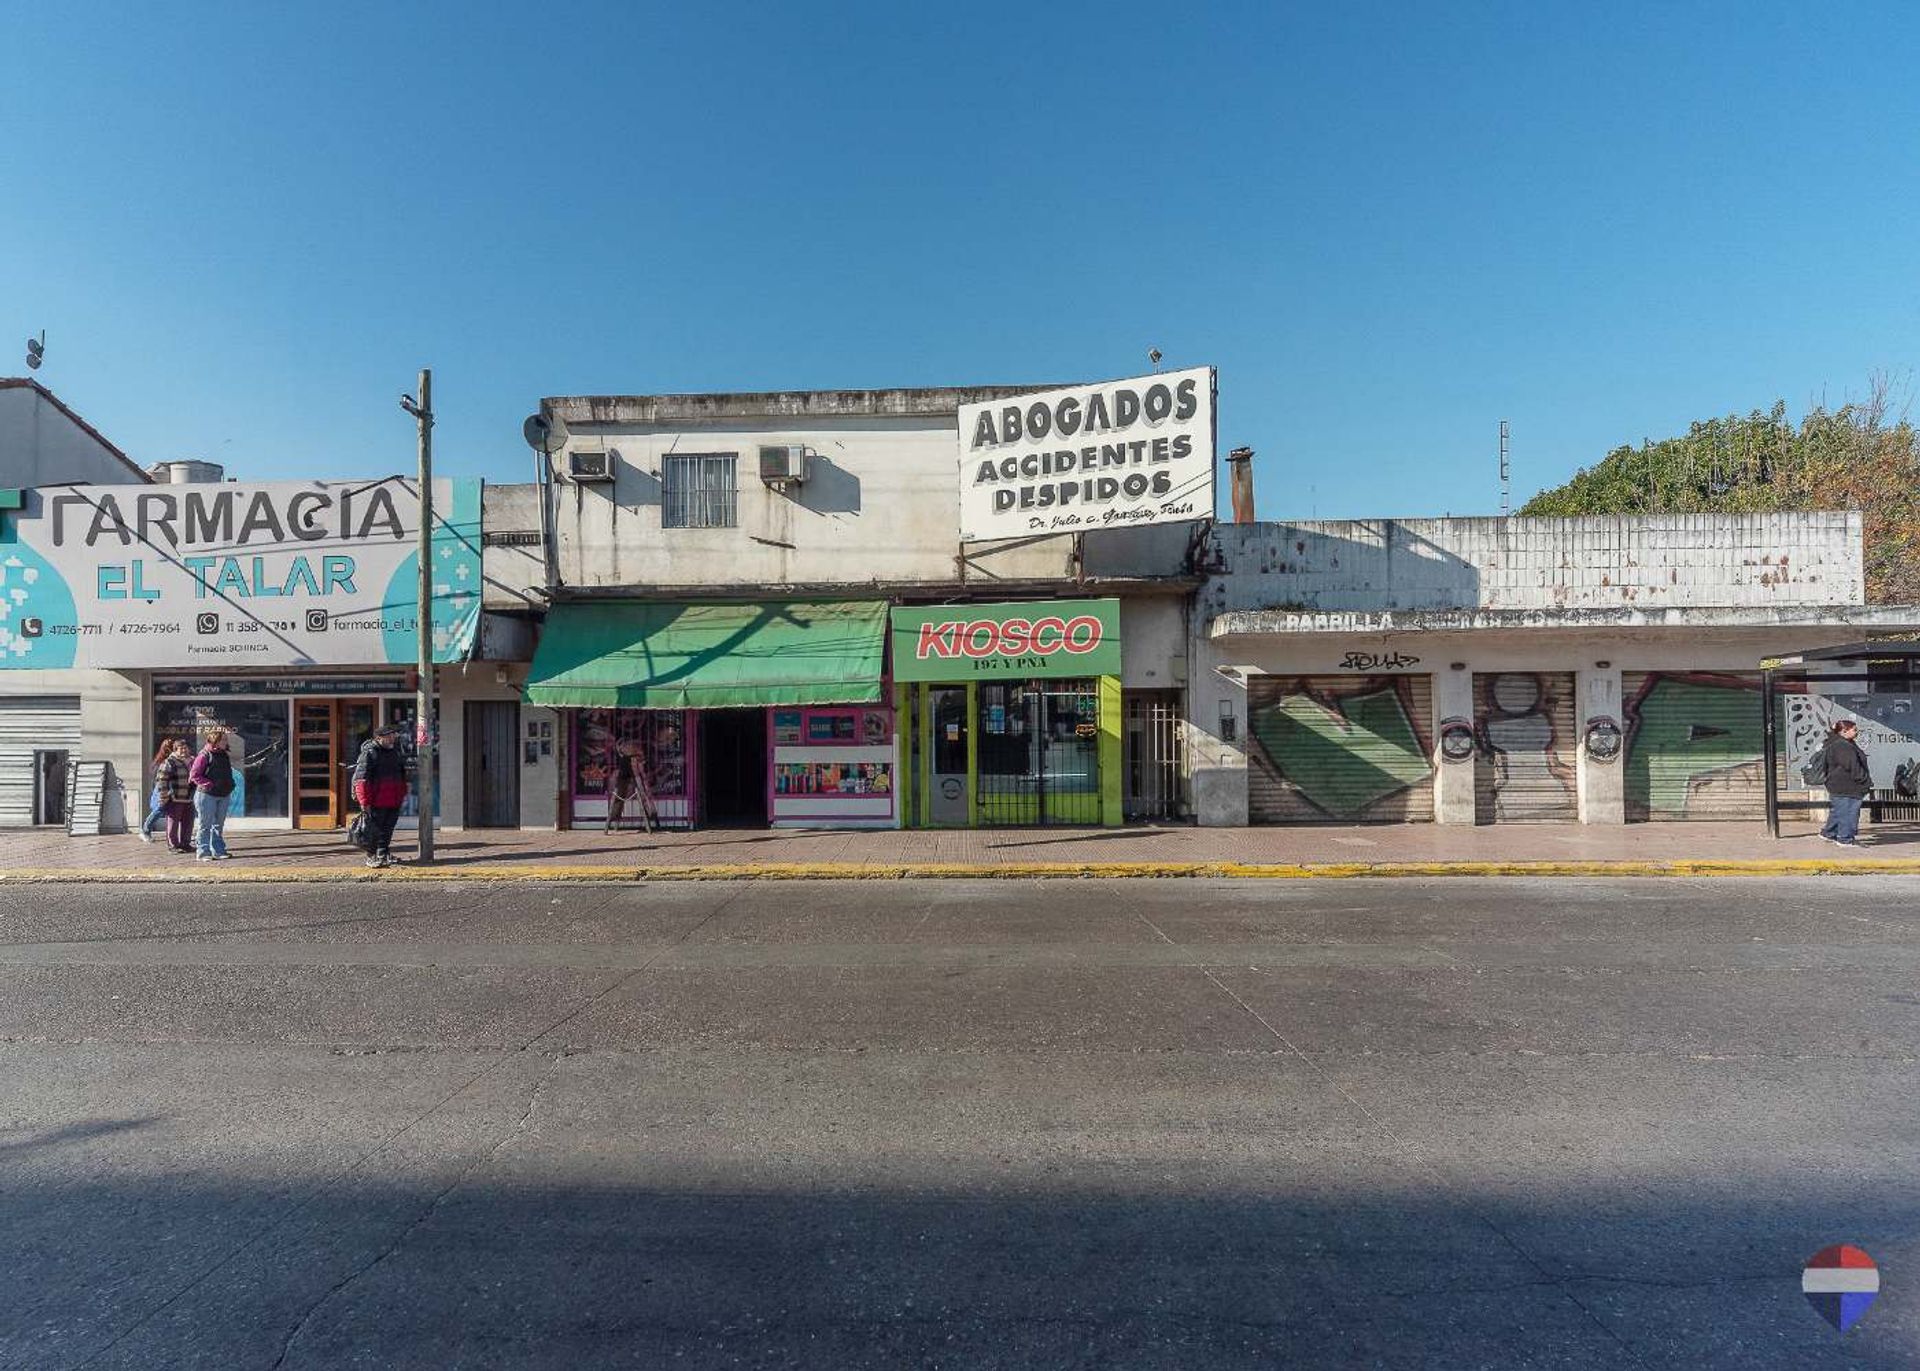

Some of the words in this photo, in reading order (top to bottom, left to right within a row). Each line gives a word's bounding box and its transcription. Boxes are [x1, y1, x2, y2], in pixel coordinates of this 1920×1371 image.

[972, 379, 1198, 449] ABOGADOS
[974, 435, 1193, 486] ACCIDENTES
[992, 470, 1172, 514] DESPIDOS
[52, 490, 405, 546] FARMACIA
[97, 558, 161, 600] EL
[184, 555, 358, 599] TALAR
[119, 623, 181, 634] 4726-7964
[917, 615, 1103, 659] KIOSCO
[973, 659, 999, 670] 197
[1016, 656, 1047, 669] PNA
[1876, 733, 1913, 743] TIGRE
